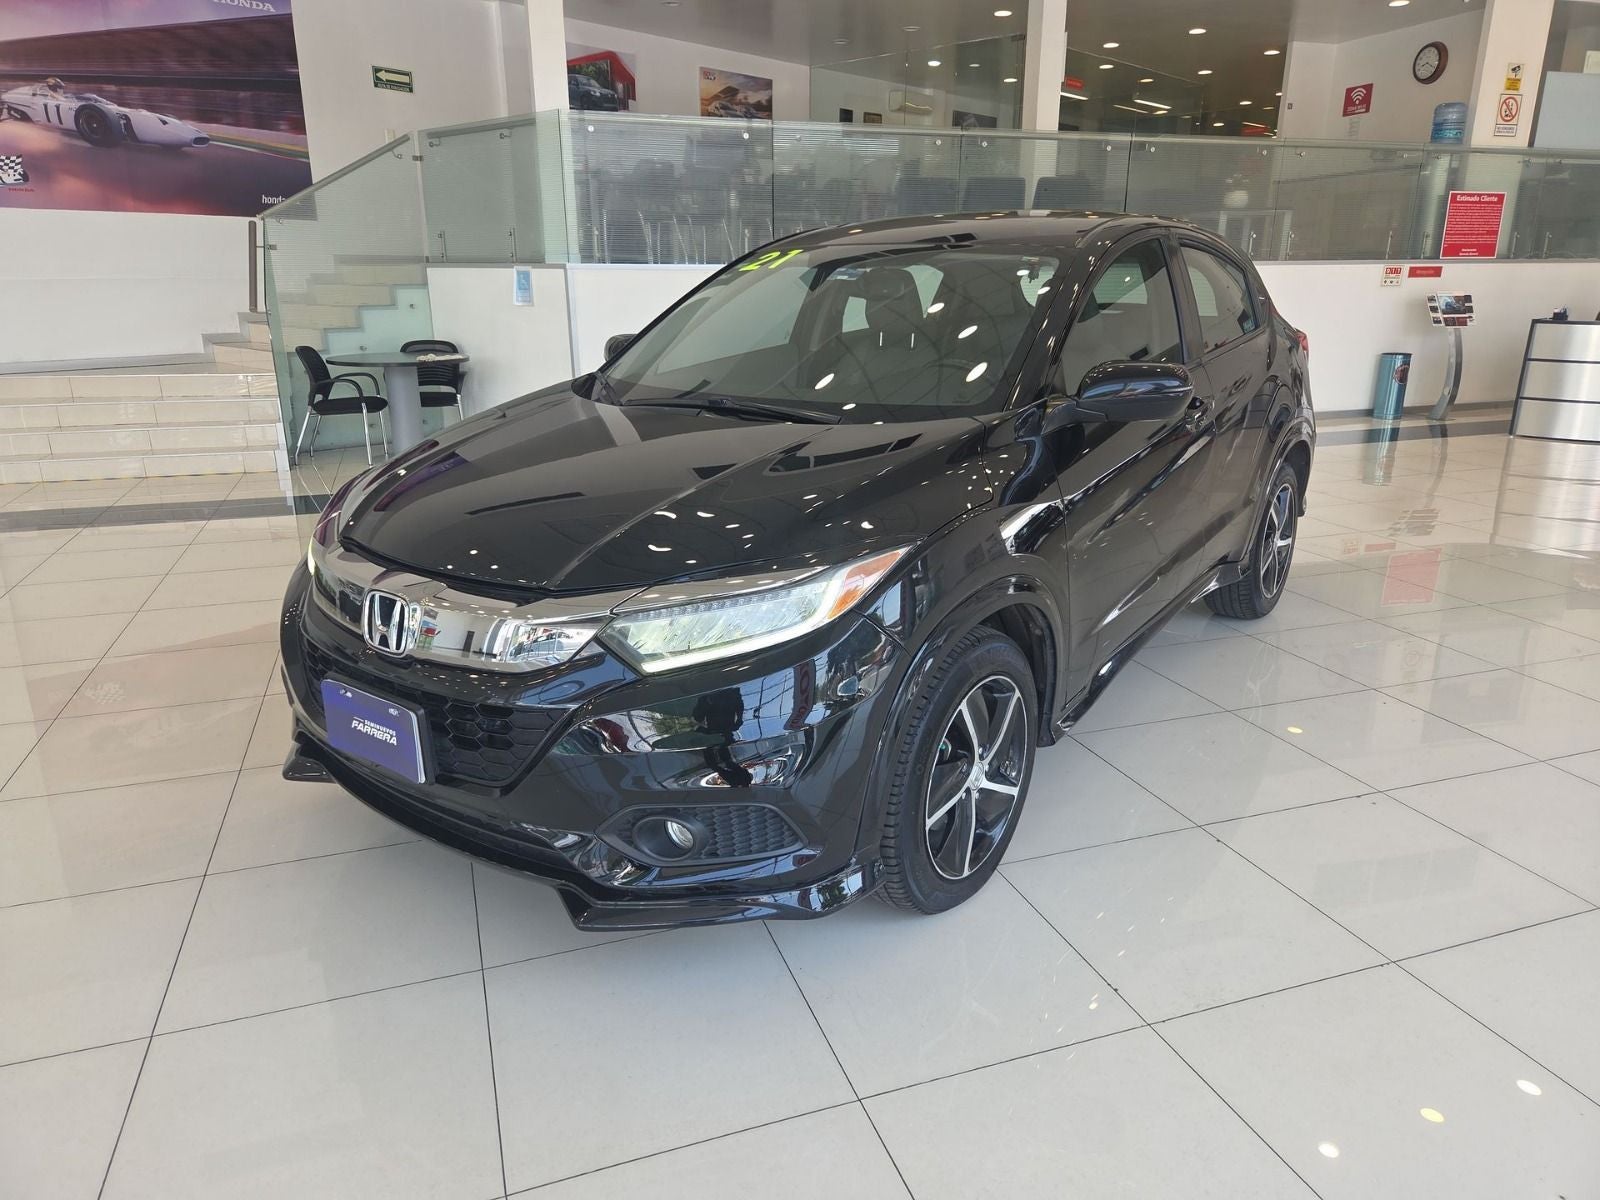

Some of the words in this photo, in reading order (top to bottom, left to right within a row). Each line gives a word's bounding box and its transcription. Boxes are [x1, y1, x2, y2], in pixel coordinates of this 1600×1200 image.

[212, 0, 276, 12] ONDA
[738, 249, 804, 272] 21
[351, 720, 397, 746] FARRERA
[364, 719, 396, 736] SEMINUEVOS
